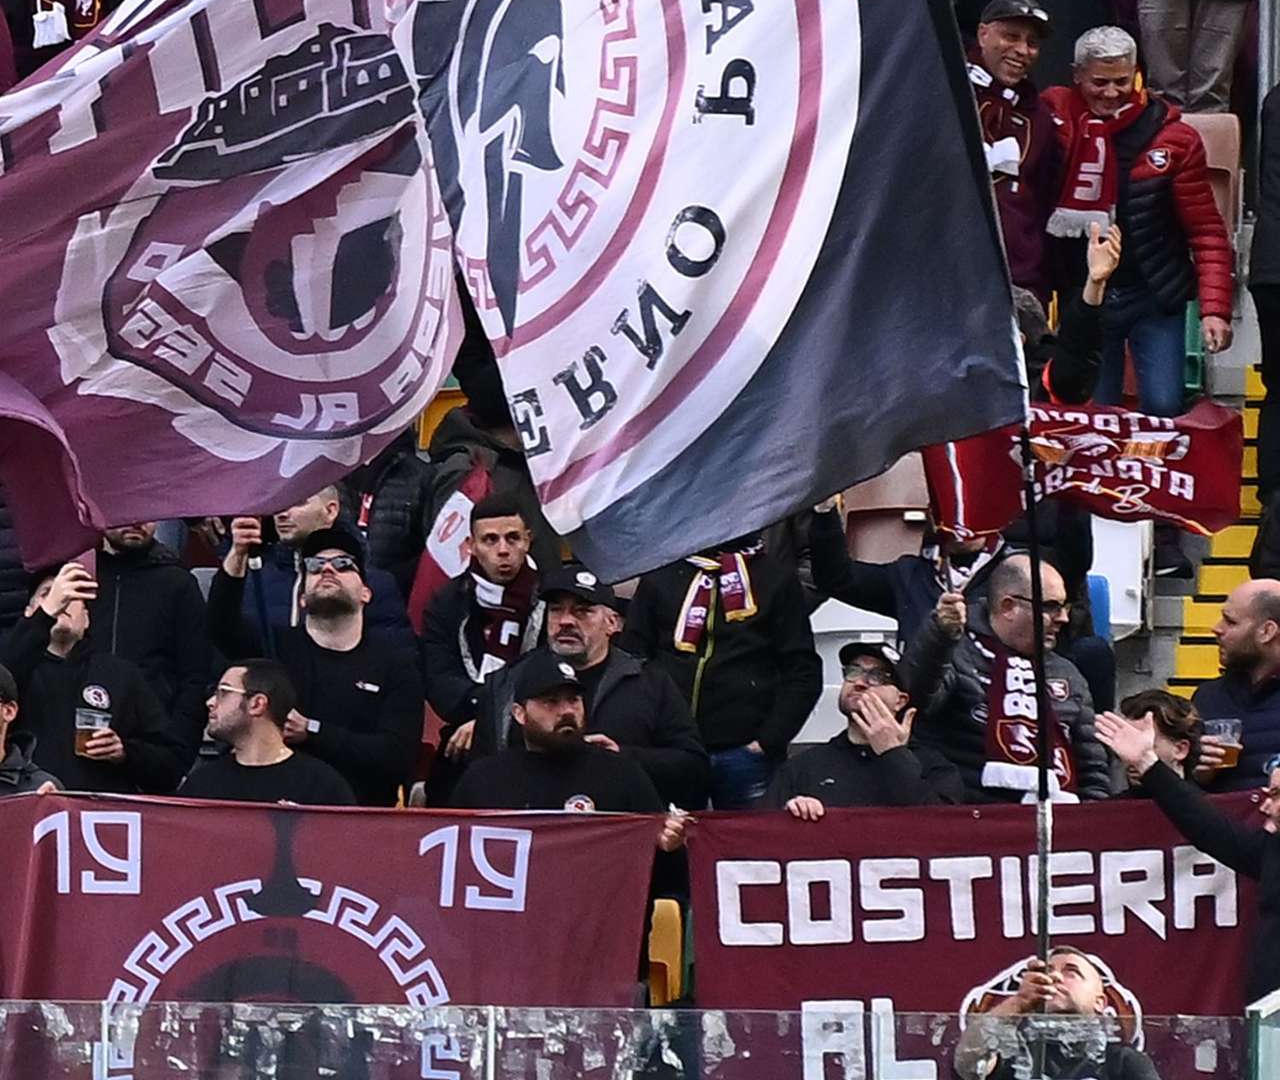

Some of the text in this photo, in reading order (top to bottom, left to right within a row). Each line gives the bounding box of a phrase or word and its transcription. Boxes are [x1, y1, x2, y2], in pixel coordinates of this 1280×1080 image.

[33, 810, 533, 912] 19 19
[715, 845, 1239, 946] COSTIERA
